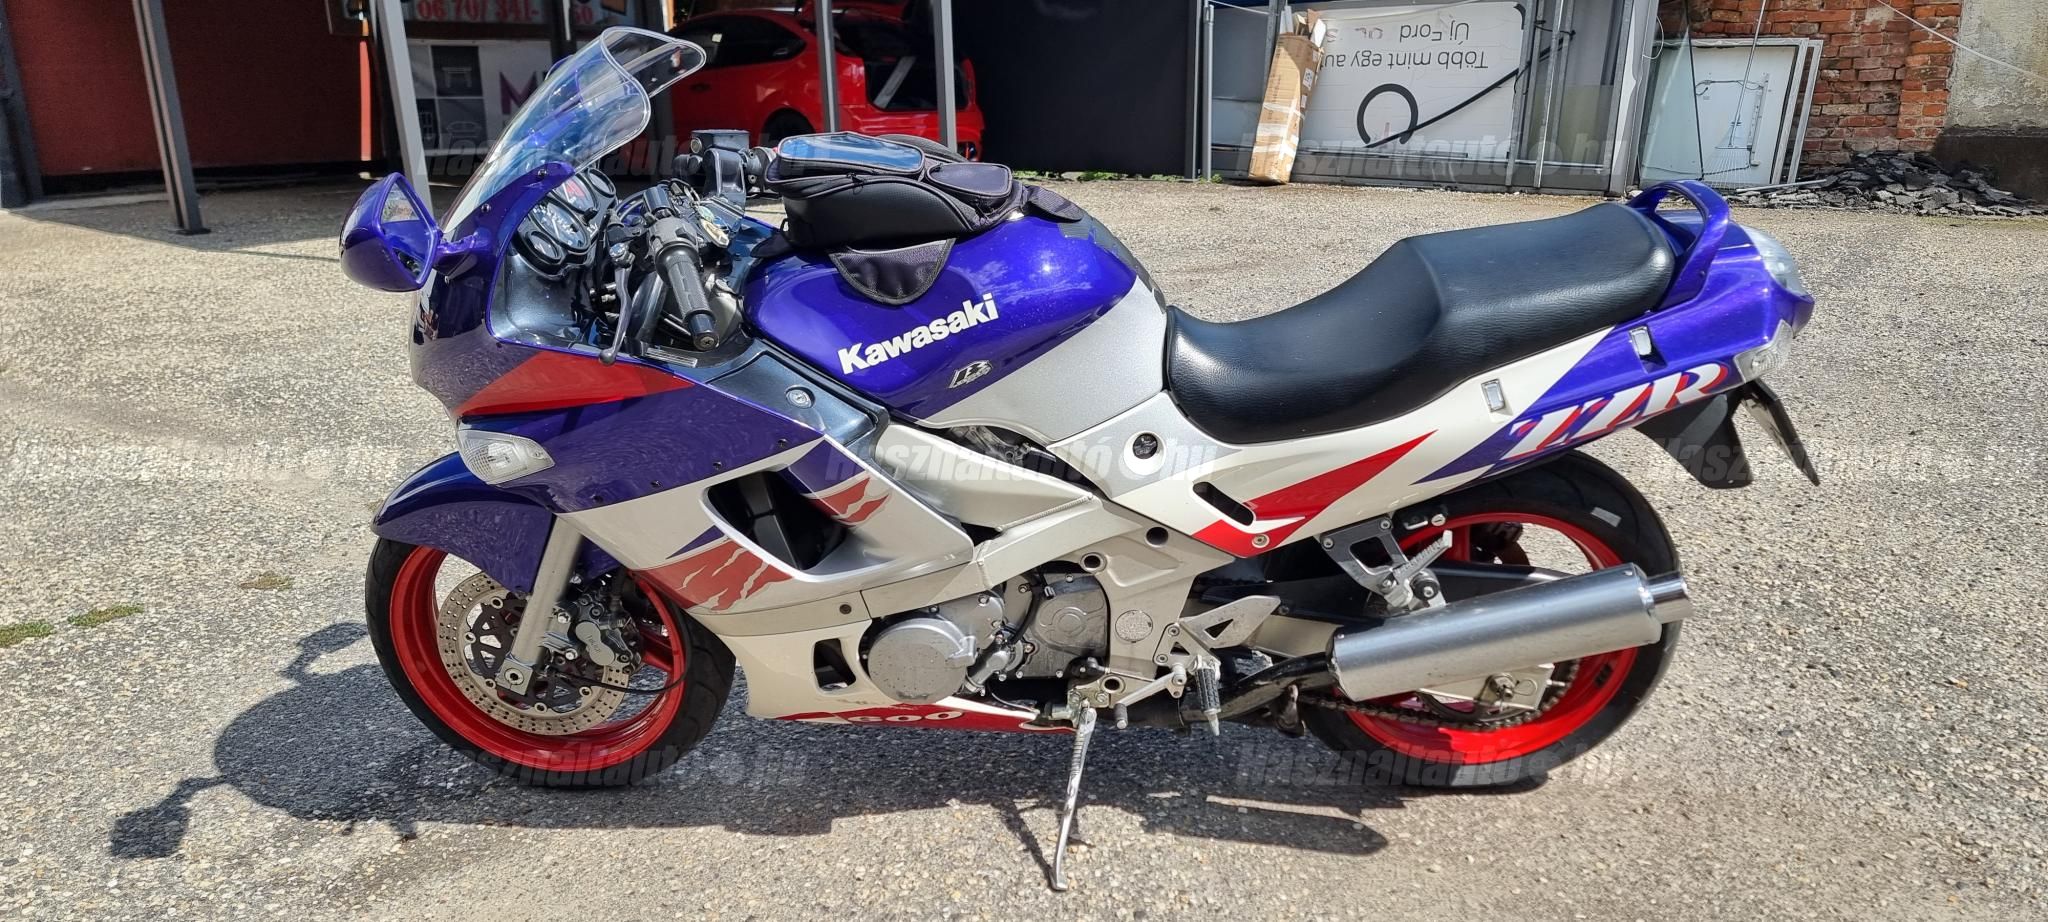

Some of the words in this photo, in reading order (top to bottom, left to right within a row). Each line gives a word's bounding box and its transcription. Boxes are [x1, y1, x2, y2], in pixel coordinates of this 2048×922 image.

[1399, 24, 1443, 43] Ford
[1320, 53, 1346, 69] au
[1351, 50, 1383, 67] egy
[1388, 51, 1432, 68] mint
[1438, 50, 1489, 69] Több
[837, 293, 1000, 375] Kawasaki
[1500, 362, 1728, 462] ZZR
